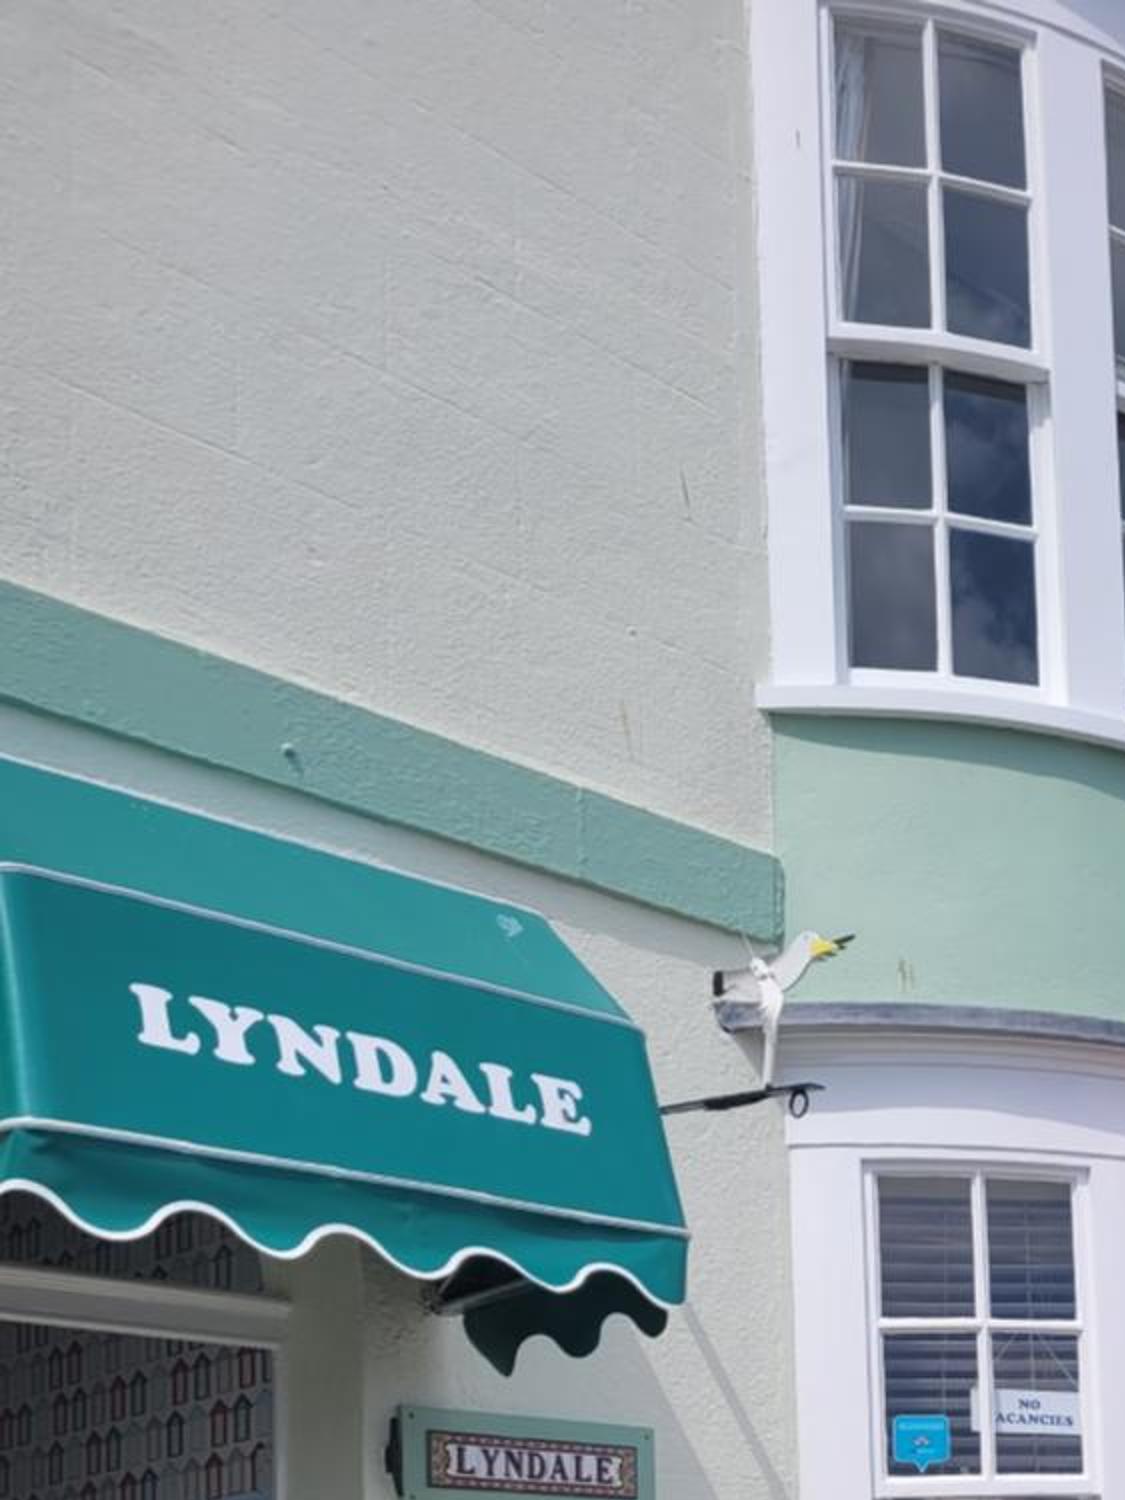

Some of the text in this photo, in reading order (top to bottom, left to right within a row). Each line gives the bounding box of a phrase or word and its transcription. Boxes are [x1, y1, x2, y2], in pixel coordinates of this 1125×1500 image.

[129, 983, 592, 1136] LYNDALE
[1017, 1399, 1042, 1410] NO
[995, 1411, 1074, 1427] ACANCIES
[455, 1447, 614, 1484] LYNDALE
